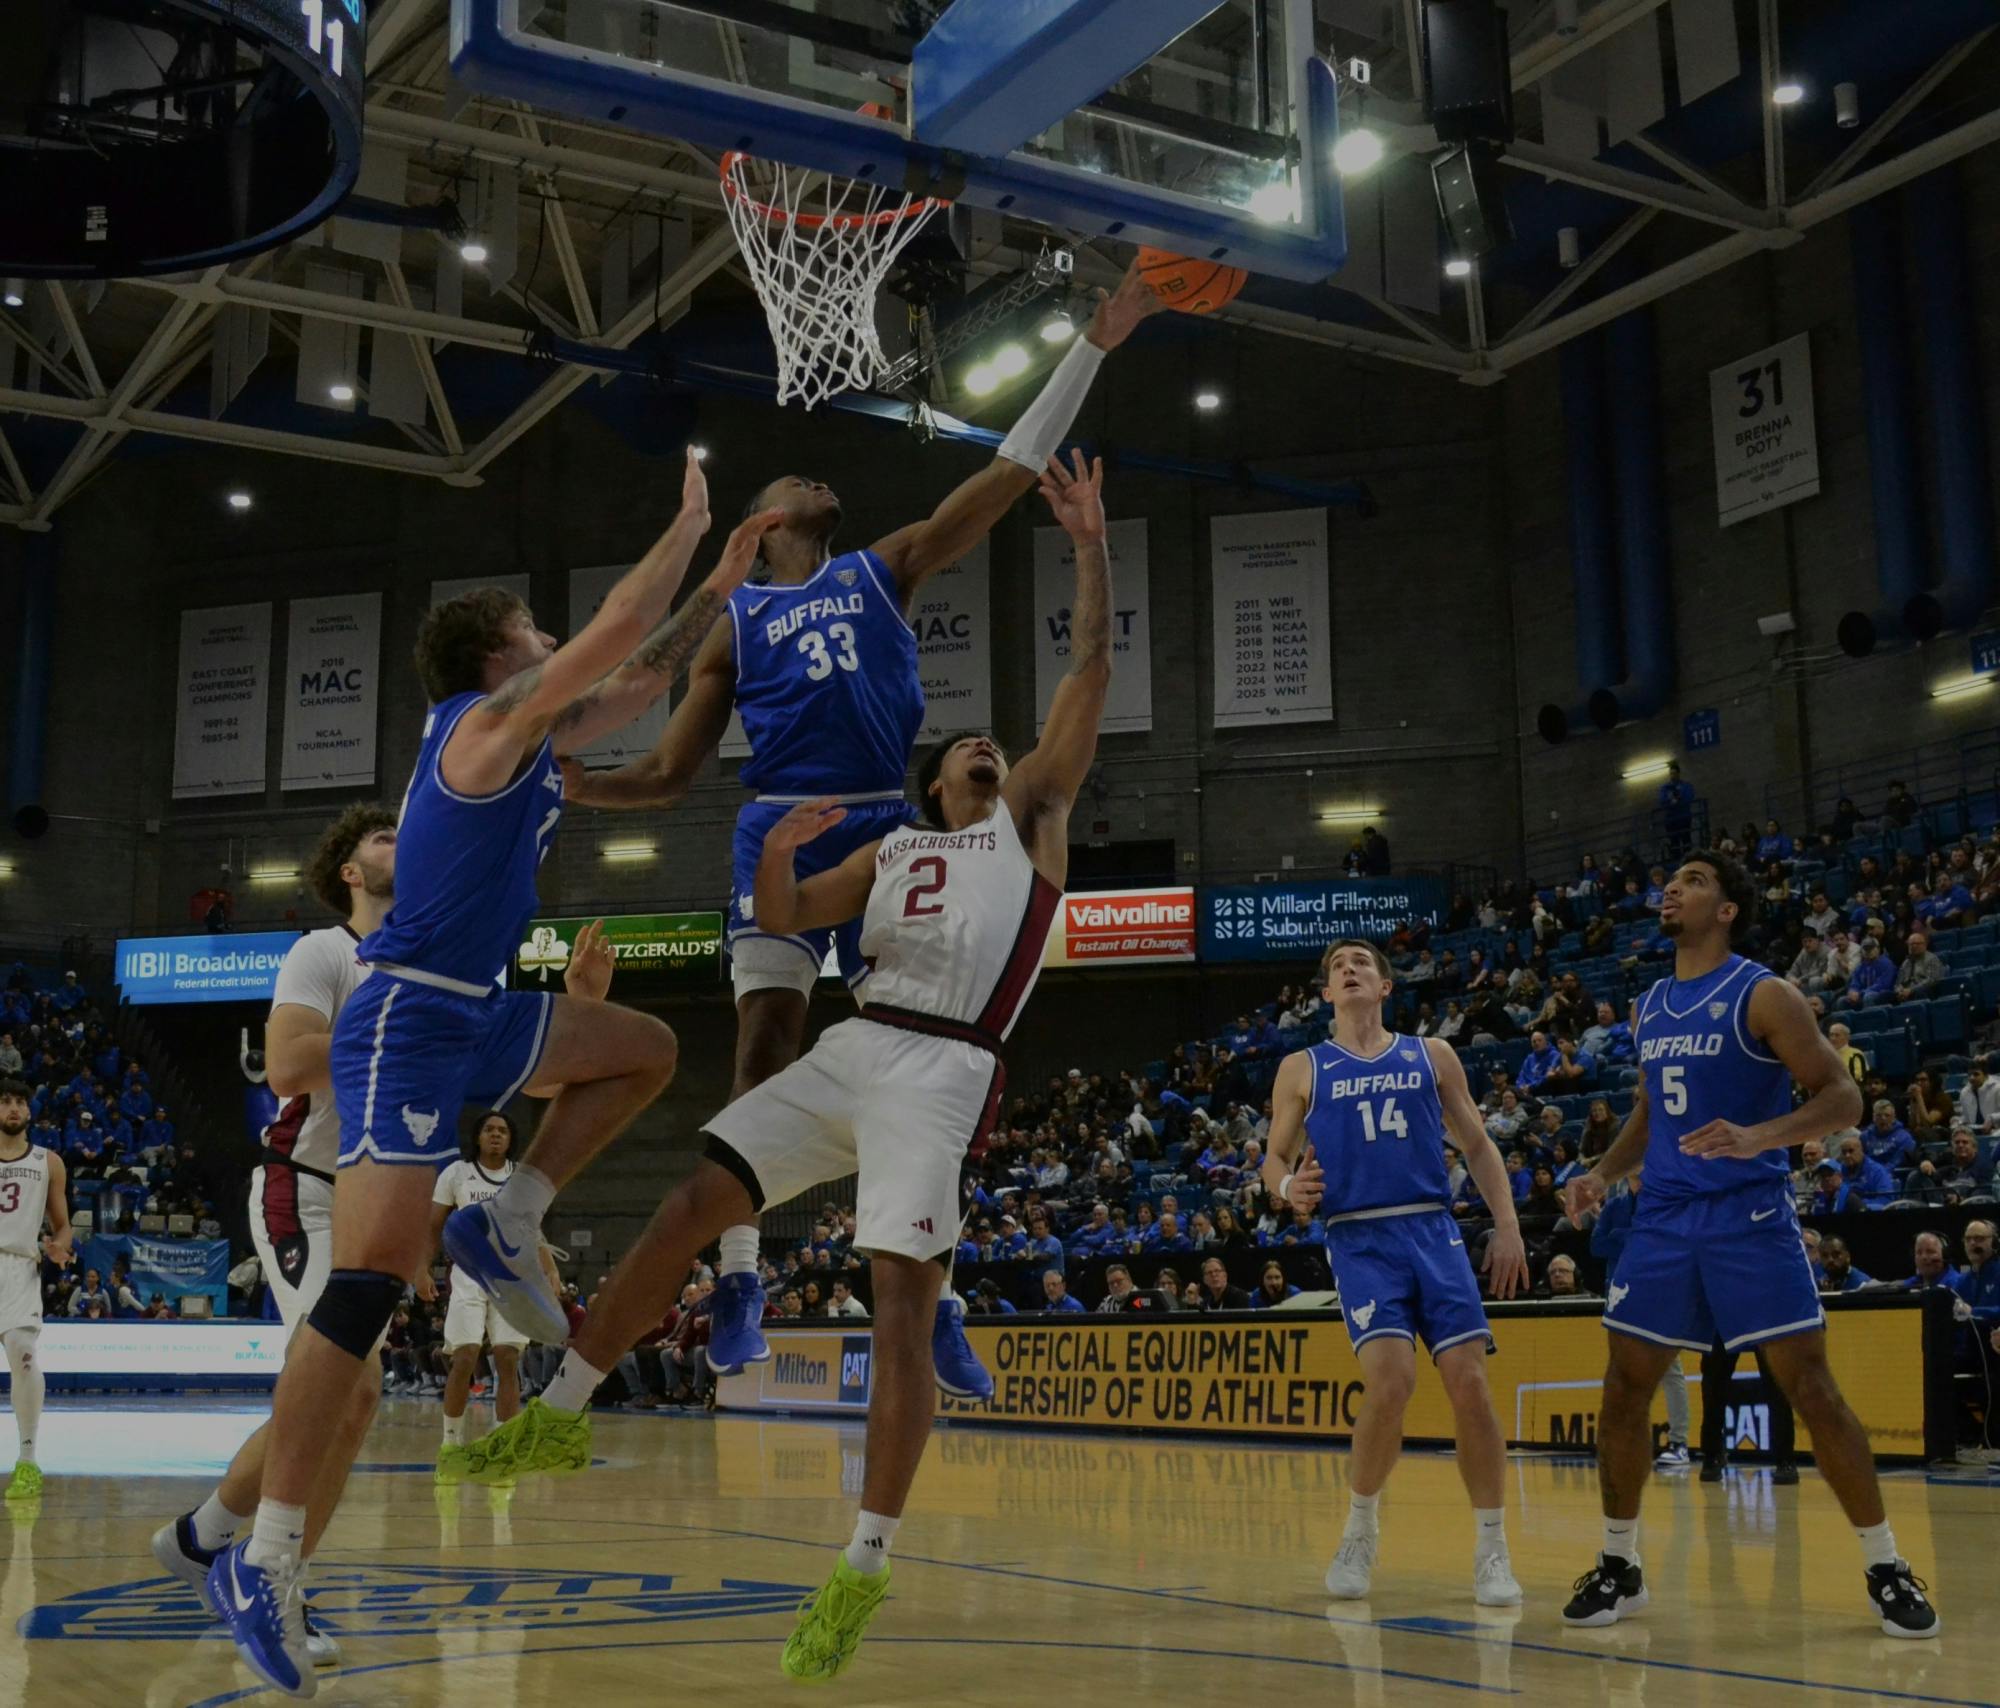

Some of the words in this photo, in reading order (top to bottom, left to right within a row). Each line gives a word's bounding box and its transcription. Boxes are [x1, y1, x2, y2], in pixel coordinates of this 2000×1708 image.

[1737, 358, 1783, 418] 31
[1735, 414, 1792, 446] BRENNA
[1746, 433, 1782, 458] DOTY
[1263, 539, 1317, 550] BASKETBALL
[1248, 551, 1286, 560] DIVISION
[1242, 559, 1298, 568] POSTSEASON
[921, 601, 950, 613] 2022
[1235, 600, 1260, 609] 2011
[1269, 597, 1294, 607] WBI
[766, 593, 864, 647] BUFFALO
[1235, 612, 1262, 622] 2015
[1269, 609, 1302, 619] WNIT
[1235, 625, 1263, 635] 2016
[1272, 622, 1308, 632] NCAA
[1235, 638, 1263, 648] 2018
[1272, 634, 1308, 645] NCAA
[797, 621, 859, 682] 33
[1235, 650, 1264, 660] 2019
[1273, 648, 1308, 658] NCAA
[321, 658, 345, 668] 2016
[1236, 663, 1266, 673] 2022
[1273, 661, 1309, 671] NCAA
[220, 665, 254, 677] COAST
[189, 678, 257, 693] CONFERENCE
[300, 669, 362, 694] MAC
[1236, 676, 1265, 686] 2024
[1274, 673, 1307, 683] WNIT
[192, 690, 253, 705] CHAMPIONS
[1236, 688, 1266, 699] 2025
[1274, 685, 1308, 696] WNIT
[300, 694, 362, 707] CHAMPIONS
[316, 729, 342, 738] NCAA
[1691, 726, 1713, 745] 111
[297, 738, 361, 751] TOURNAMENT
[877, 831, 997, 871] MASSACHUSETTS
[903, 856, 947, 918] 2
[1261, 893, 1326, 915] Millard
[1331, 891, 1410, 912] Fillmore
[1070, 902, 1191, 928] Valvoline
[1261, 915, 1352, 937] Suburban
[1074, 940, 1120, 953] Instant
[1121, 938, 1138, 950] Oil
[175, 951, 284, 974] Broadview
[669, 958, 688, 969] NY
[174, 978, 208, 989] Federal
[210, 976, 239, 988] Credit
[240, 975, 269, 986] Union
[1641, 1033, 1724, 1063] BUFFALO
[1332, 1071, 1422, 1100] BUFFALO
[1662, 1065, 1688, 1116] 5
[1356, 1097, 1409, 1142] 14
[996, 1331, 1116, 1372] OFFICIAL
[1126, 1328, 1309, 1373] EQUIPMENT
[775, 1352, 828, 1385] Milton
[842, 1352, 868, 1387] CAT
[1104, 1376, 1145, 1419] OF
[1153, 1378, 1193, 1421] UB
